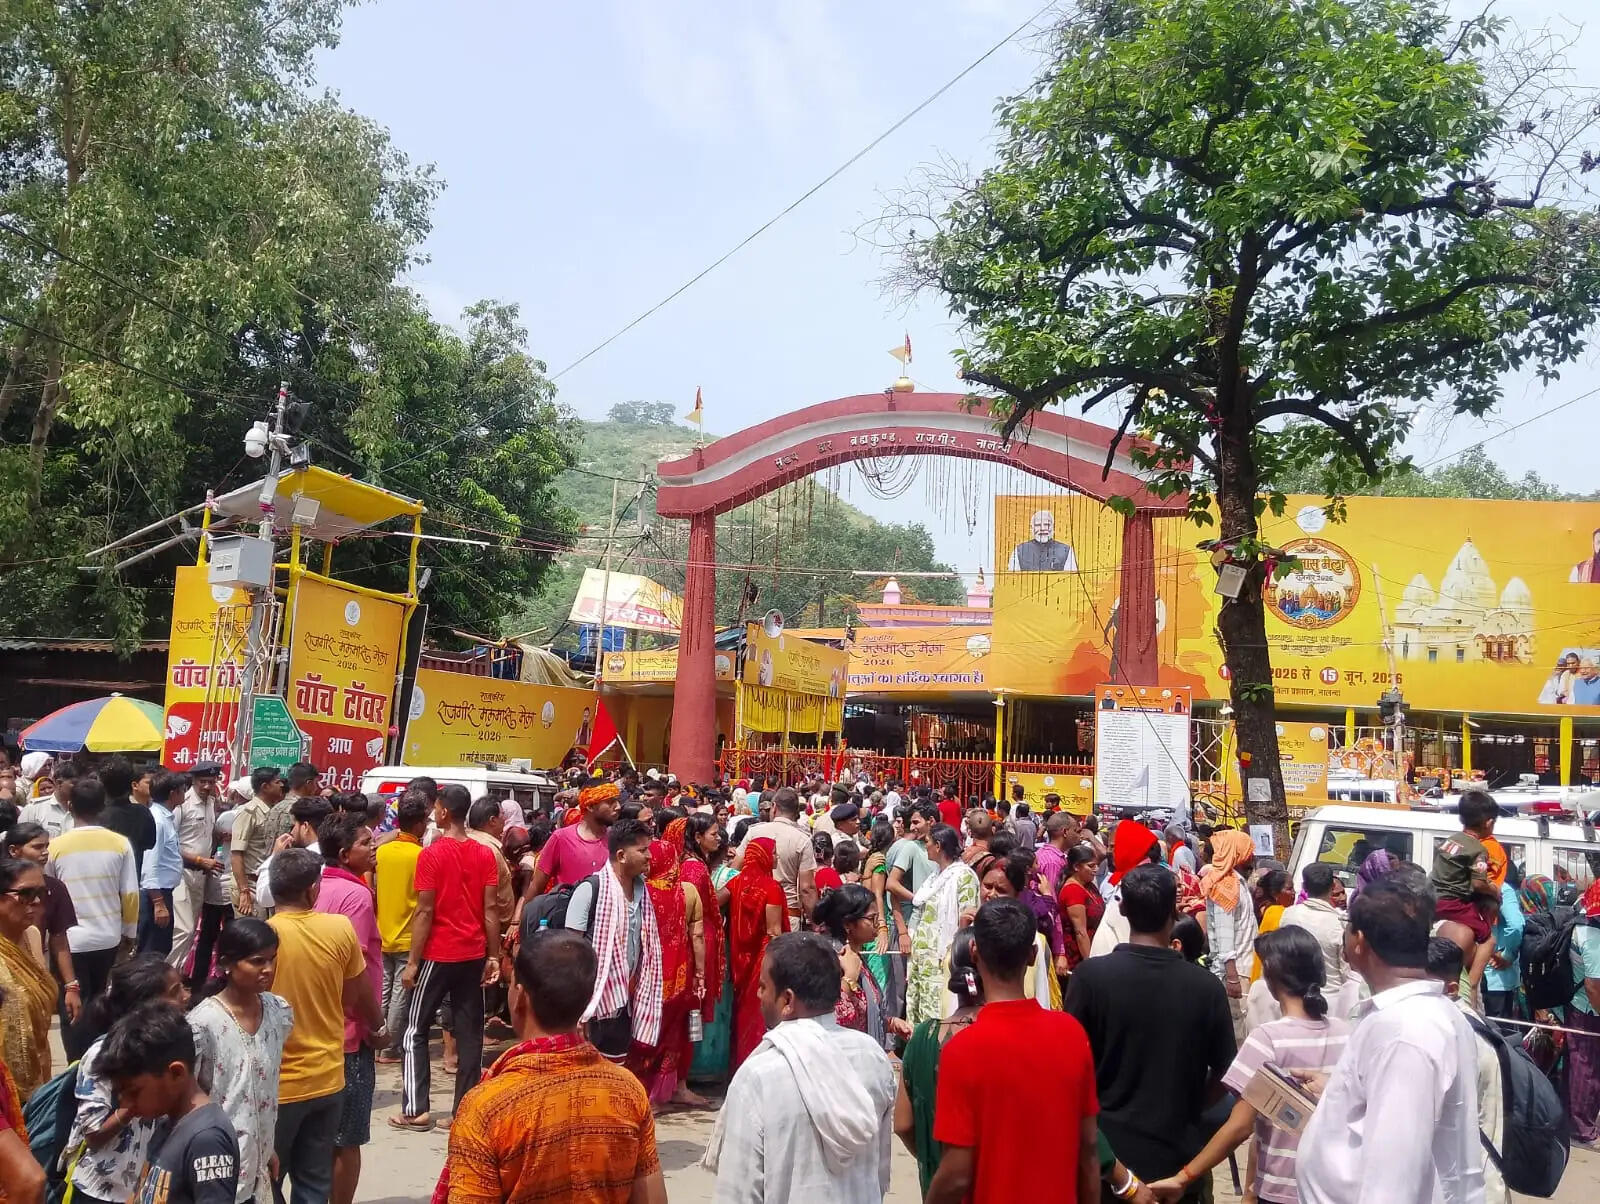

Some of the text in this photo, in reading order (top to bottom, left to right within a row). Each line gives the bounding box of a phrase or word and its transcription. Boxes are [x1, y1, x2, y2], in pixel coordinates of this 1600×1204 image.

[172, 659, 210, 687] वॉच
[337, 660, 358, 671] 2026
[1301, 665, 1312, 681] से
[1320, 668, 1337, 681] 15
[878, 673, 893, 683] का
[896, 670, 931, 684] हार्दिक
[296, 673, 387, 724] वॉच टॉवर
[437, 700, 480, 727] राजगीर
[478, 731, 501, 741] 2026
[327, 738, 353, 755] आप
[193, 1154, 234, 1171] CLEAN
[196, 1165, 234, 1182] BASIC
